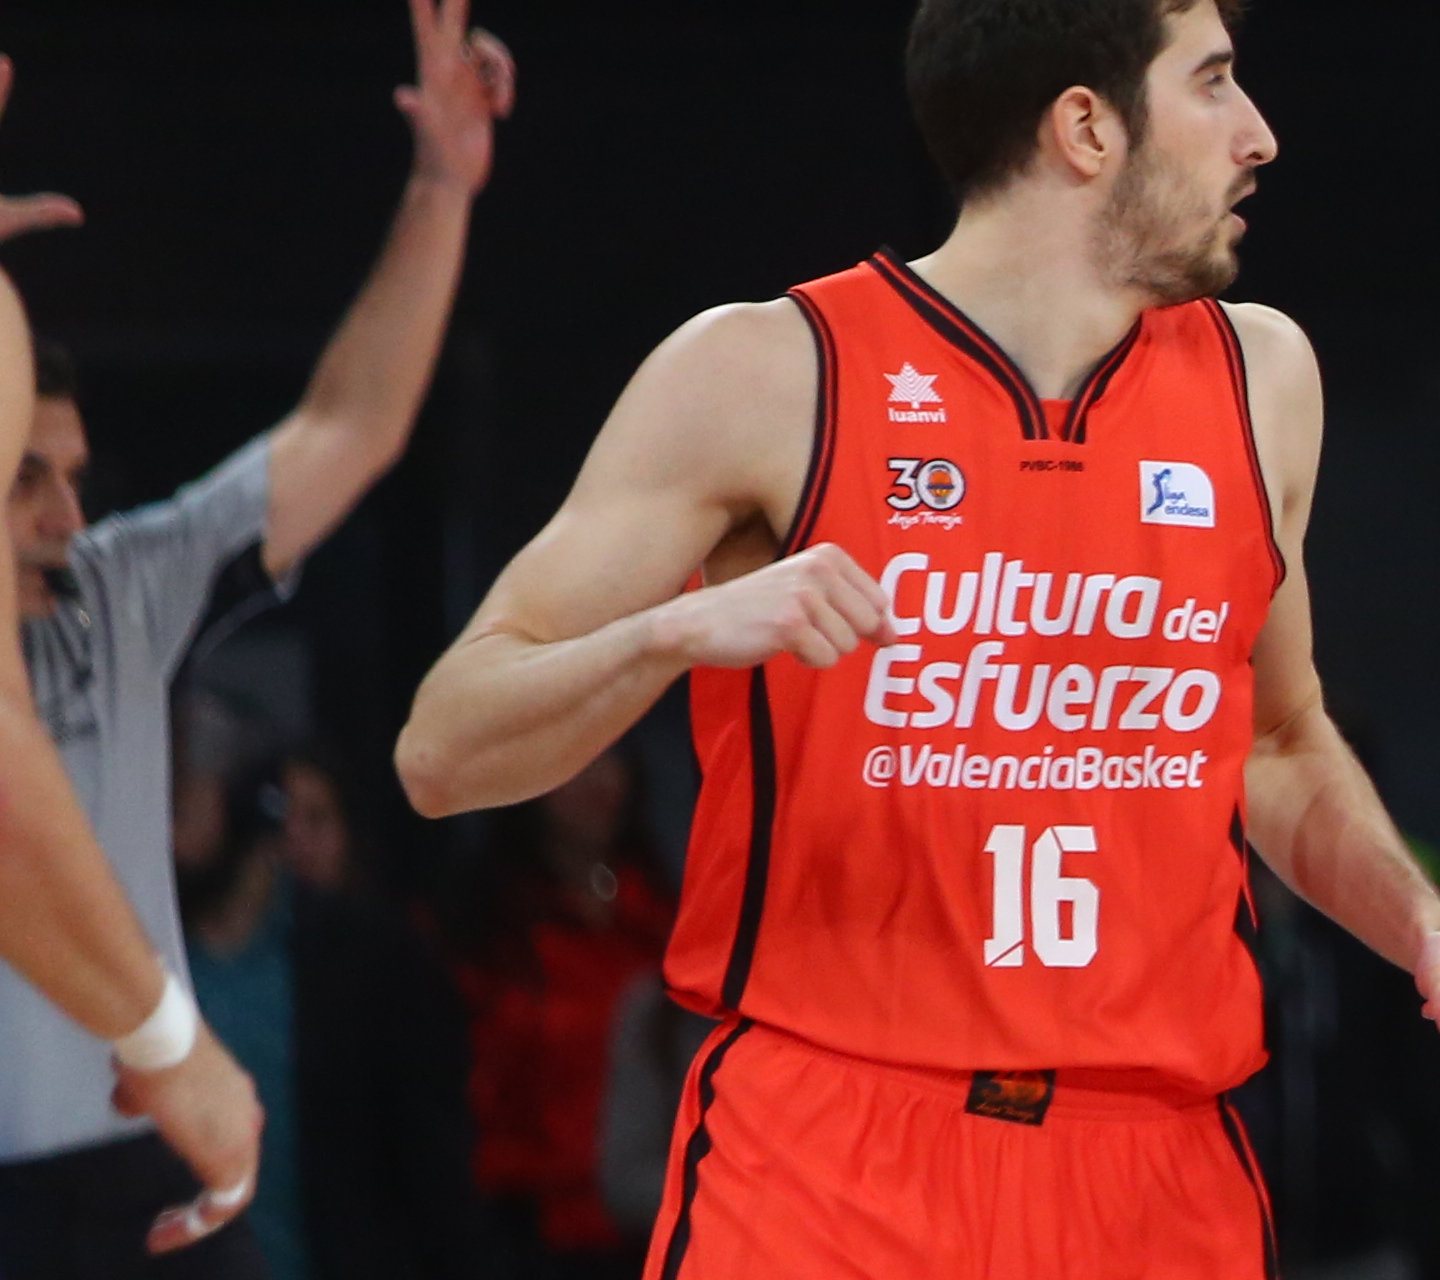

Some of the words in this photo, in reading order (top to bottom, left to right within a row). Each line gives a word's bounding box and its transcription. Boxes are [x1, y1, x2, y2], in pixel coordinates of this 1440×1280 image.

[888, 408, 947, 424] luanvi
[885, 457, 966, 511] 30
[880, 552, 1162, 639] Cultura
[1163, 598, 1229, 643] del
[864, 641, 1222, 733] Esfuerzo
[862, 743, 1208, 791] @ValenciaBasket
[983, 824, 1100, 968] 16
